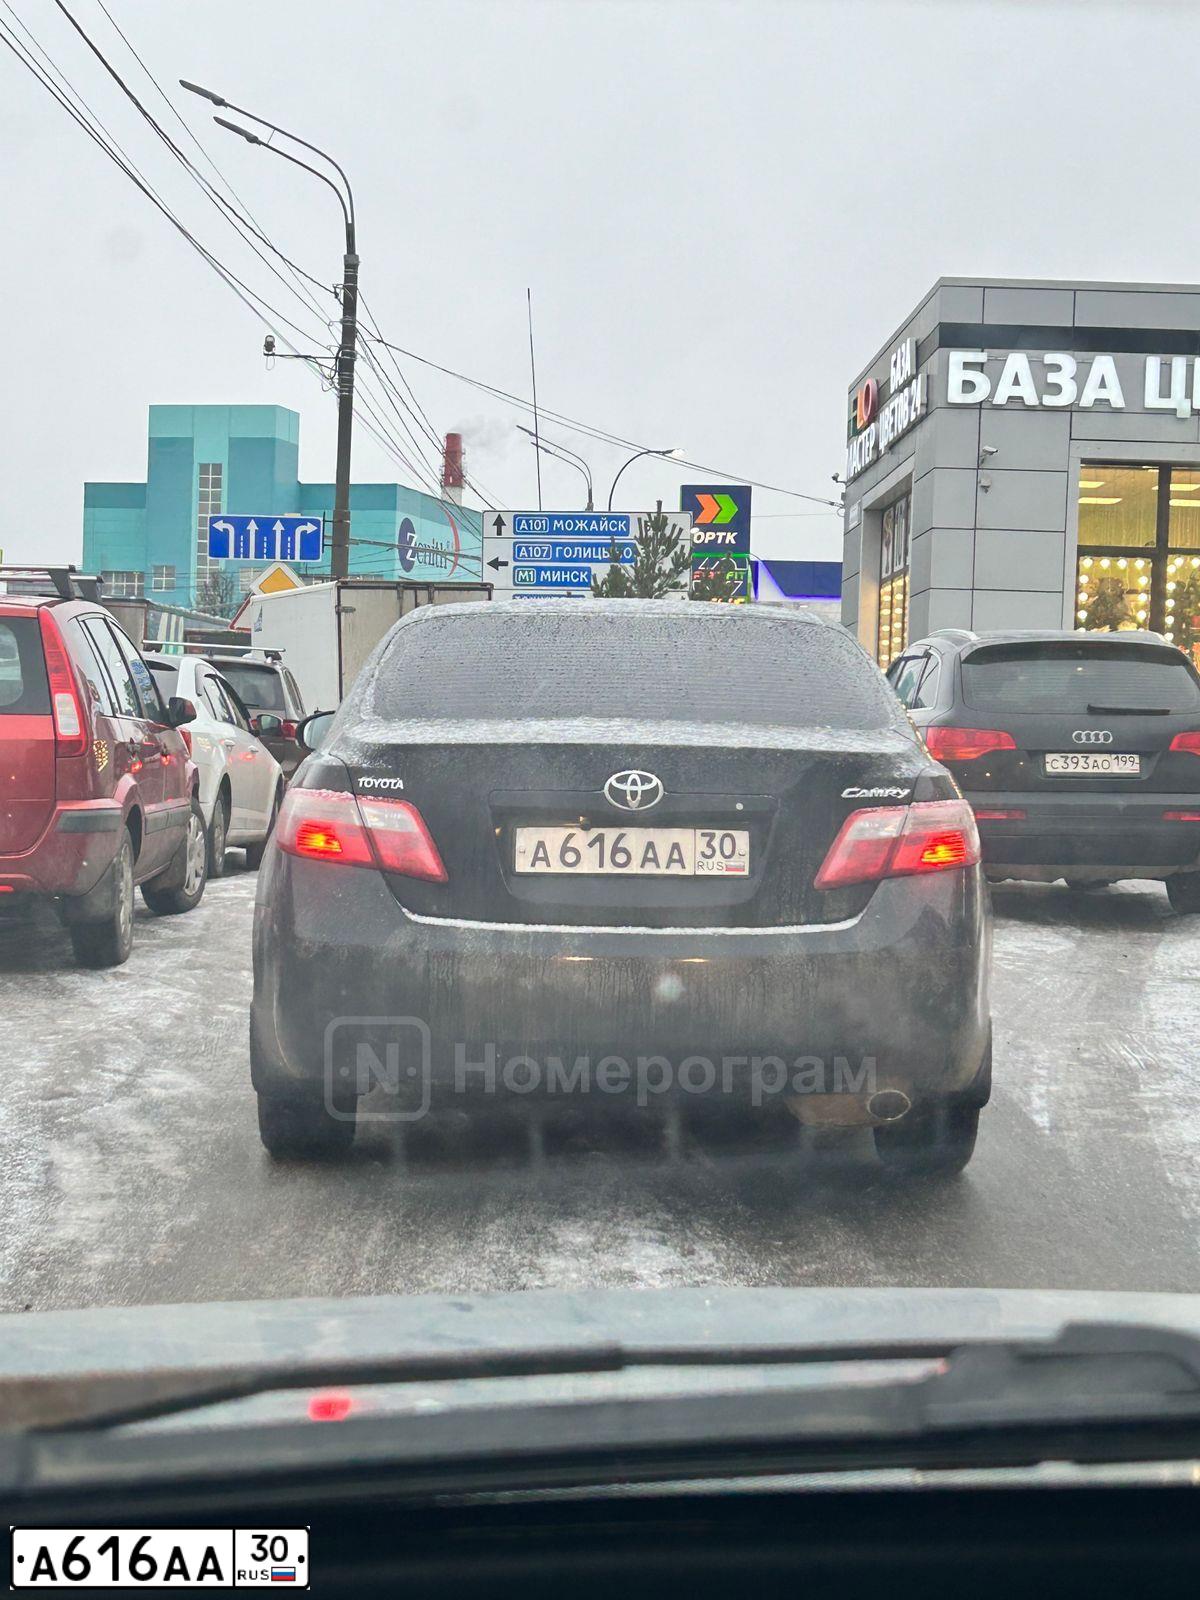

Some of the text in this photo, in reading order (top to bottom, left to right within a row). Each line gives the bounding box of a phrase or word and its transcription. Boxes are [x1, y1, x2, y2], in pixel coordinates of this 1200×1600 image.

[890, 337, 913, 394] БАЗА
[947, 351, 1126, 408] БАЗА
[878, 387, 909, 455] ЦВЕТОВ
[518, 516, 627, 531] А101 МОЖАЙСК
[518, 546, 633, 561] А107 ГОЛИЦЫО
[517, 569, 589, 583] М1 МИНСК
[1050, 755, 1136, 770] С393АО 199
[357, 777, 404, 790] TOYOTA
[530, 831, 737, 870] А616АА 30
[697, 861, 724, 872] RUS
